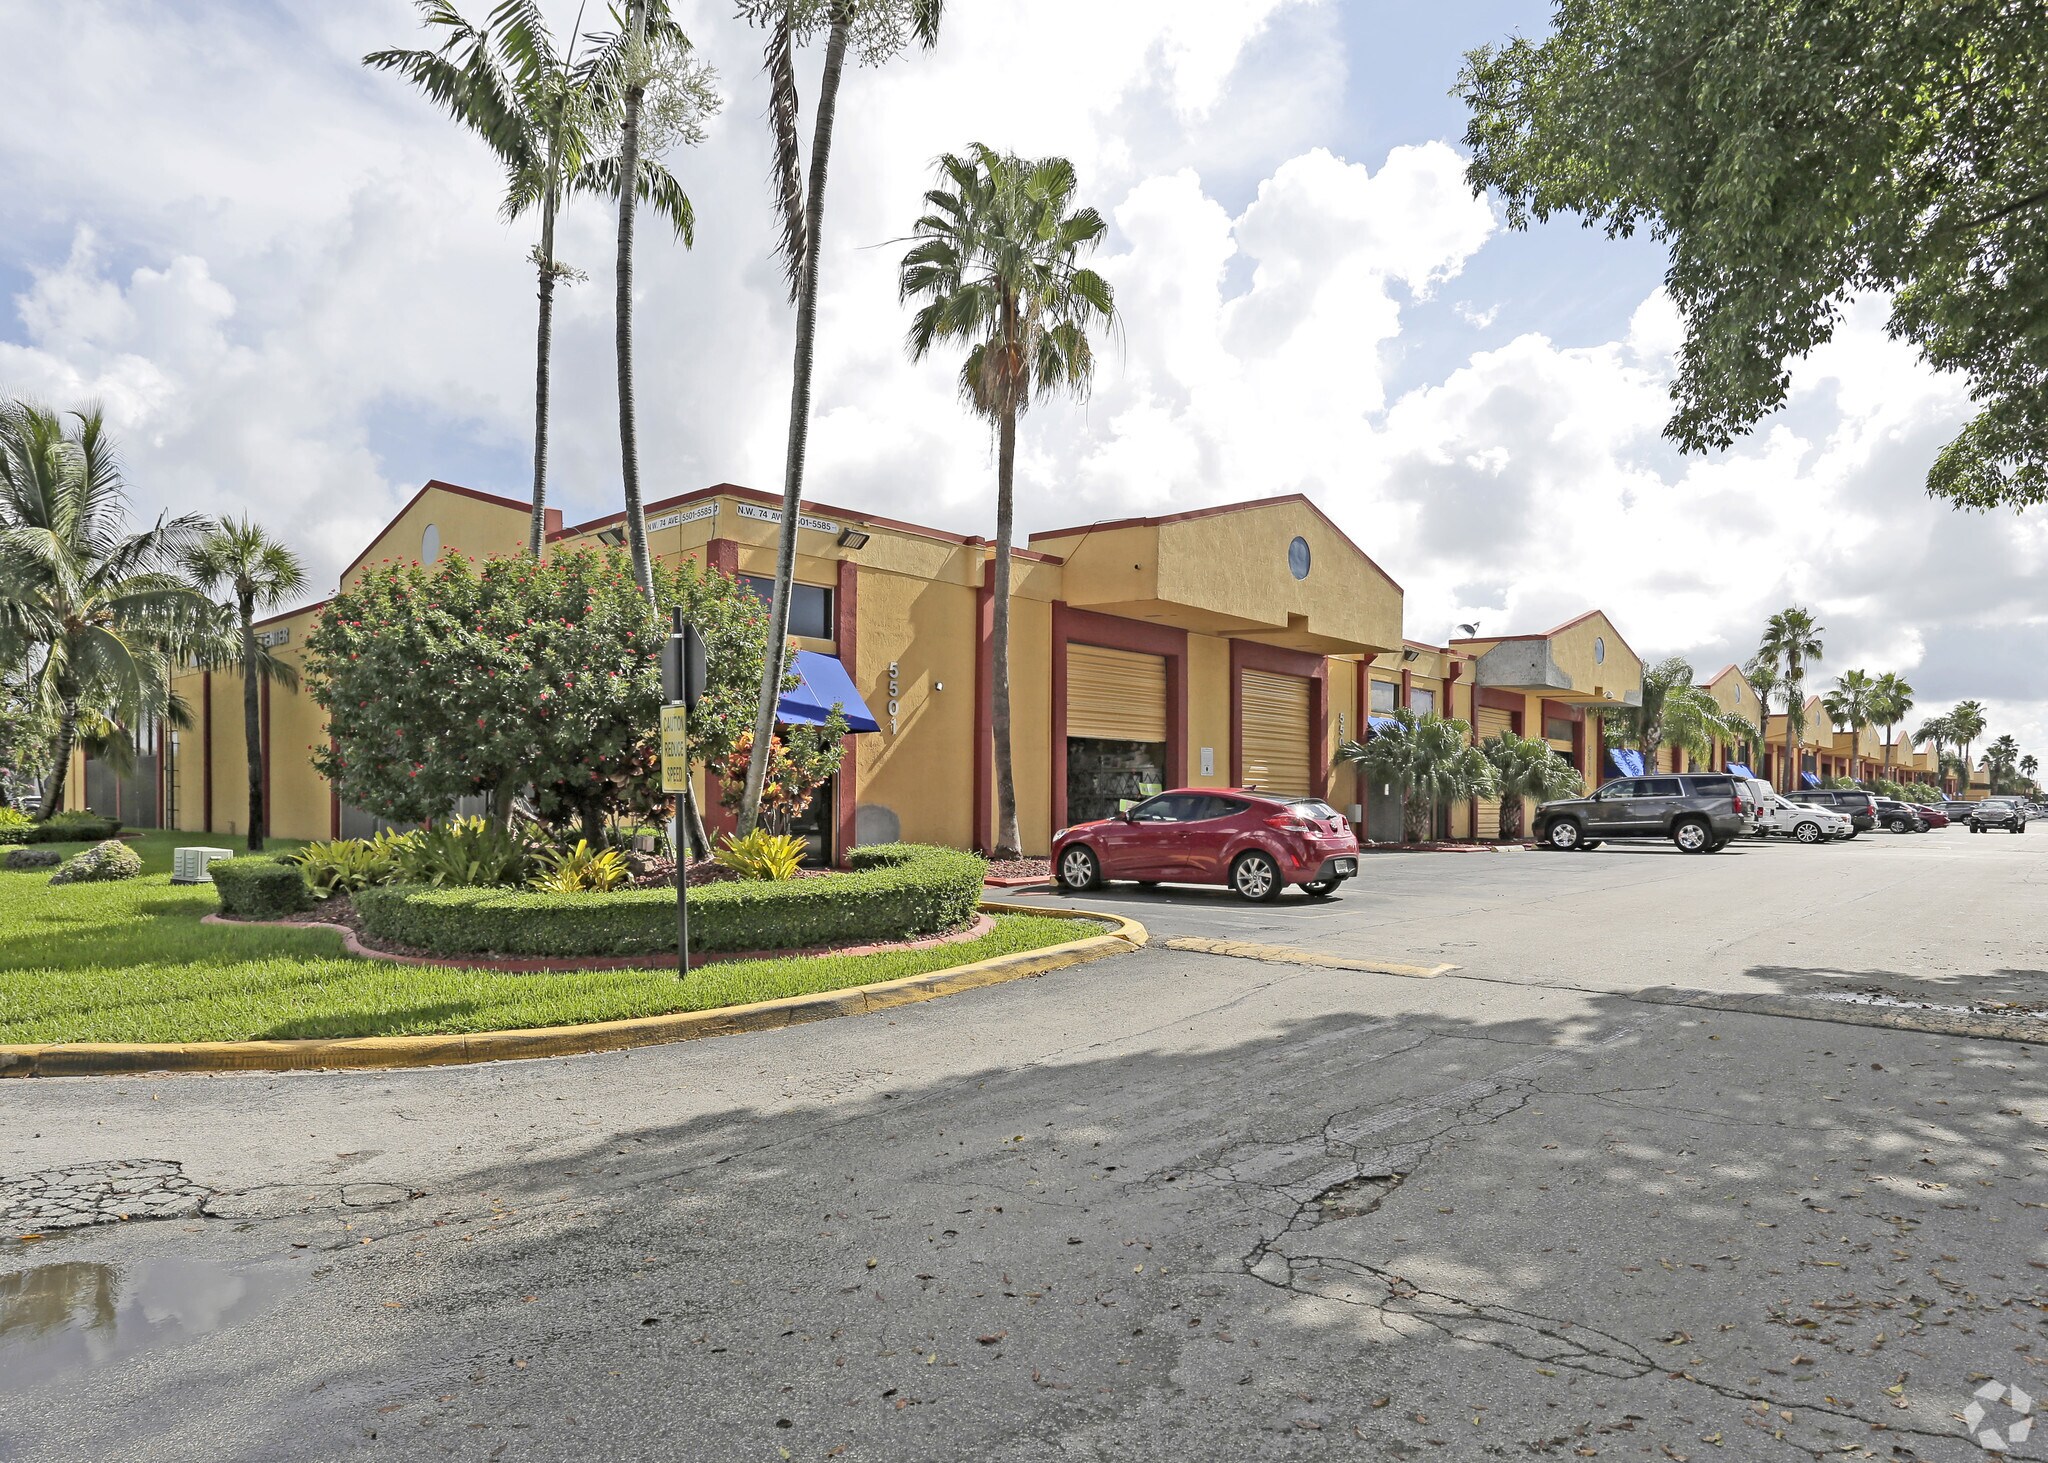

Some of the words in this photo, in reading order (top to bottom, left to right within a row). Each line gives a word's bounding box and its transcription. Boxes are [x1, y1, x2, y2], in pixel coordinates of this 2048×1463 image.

[660, 519, 666, 527] 74
[682, 506, 712, 522] 5501-5585
[737, 505, 756, 517] N.W.
[758, 509, 768, 518] 74
[771, 512, 783, 522] AV
[888, 661, 899, 736] 5501
[663, 716, 684, 732] CAUTION
[665, 741, 684, 757] REDUCE
[667, 766, 683, 782] SPEED
